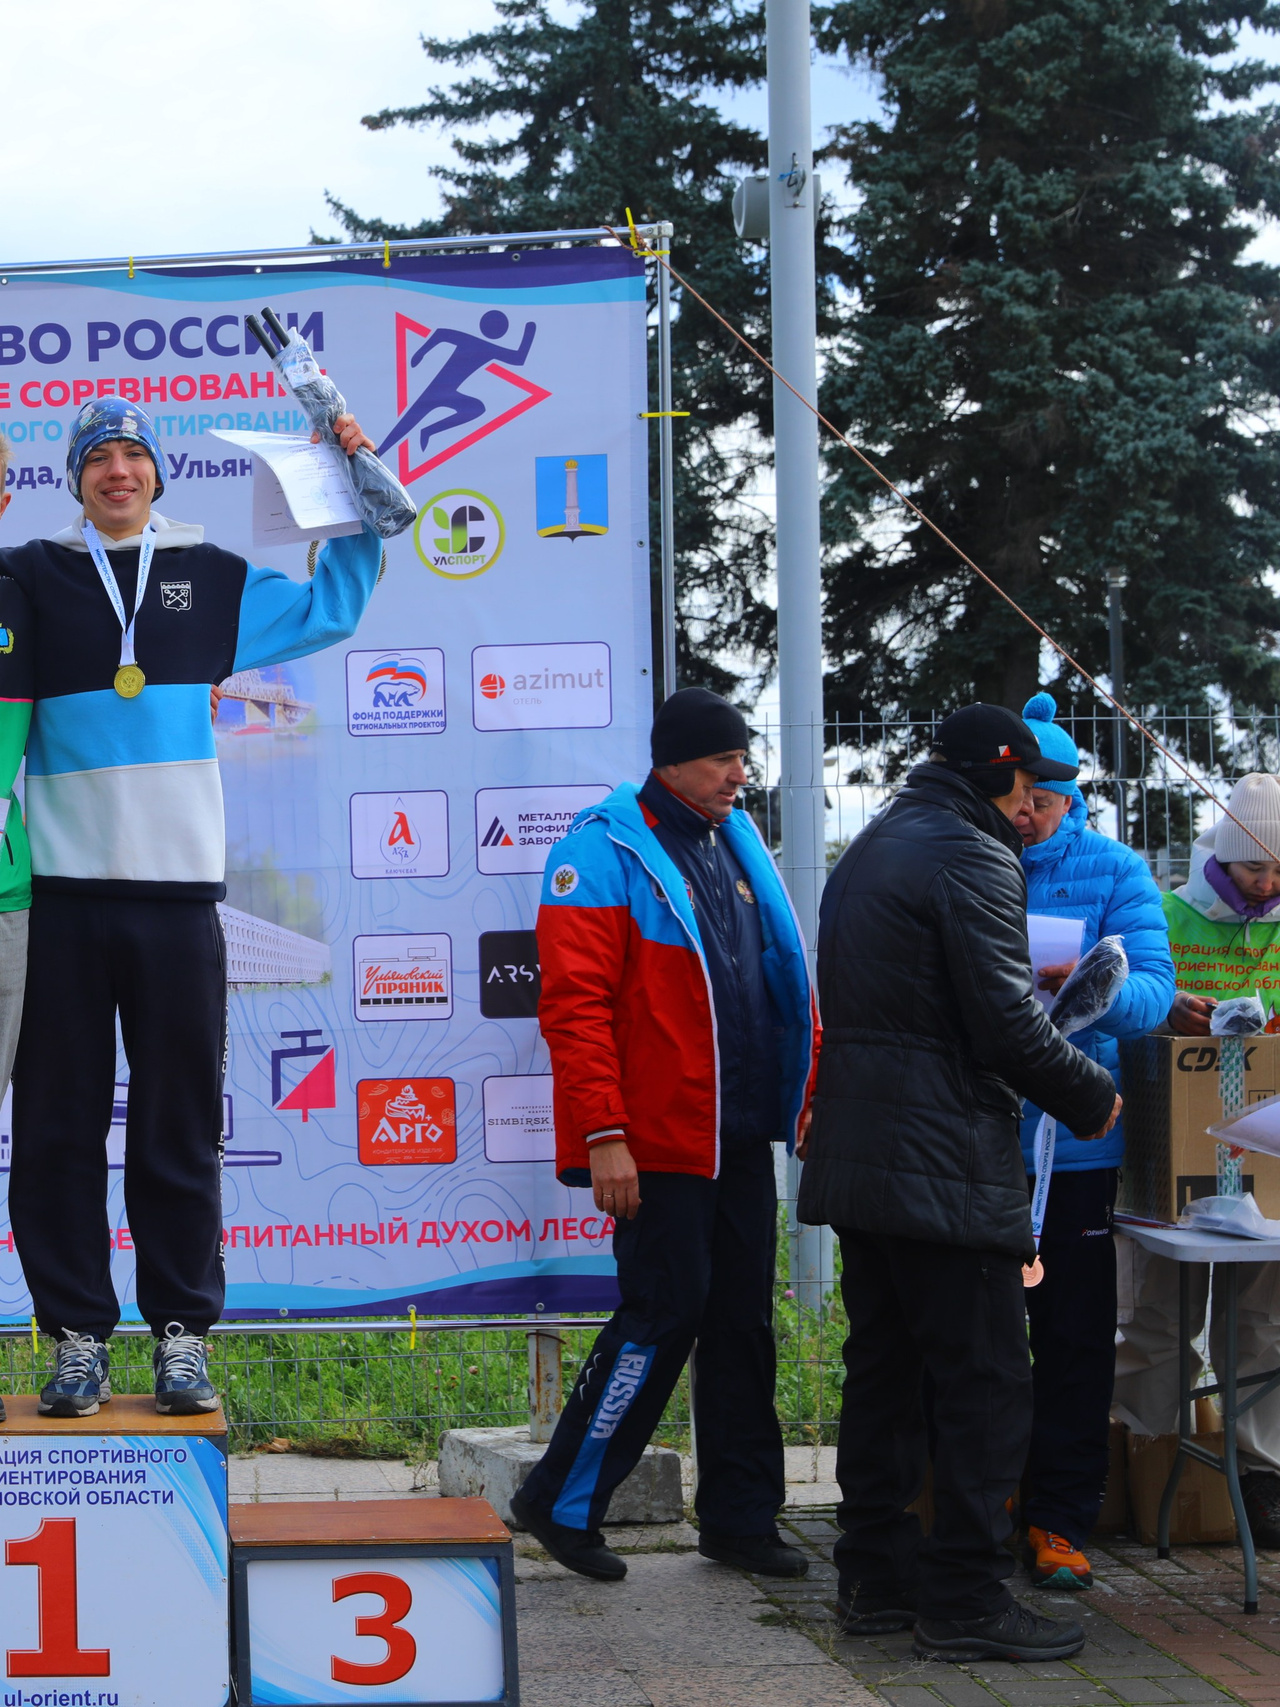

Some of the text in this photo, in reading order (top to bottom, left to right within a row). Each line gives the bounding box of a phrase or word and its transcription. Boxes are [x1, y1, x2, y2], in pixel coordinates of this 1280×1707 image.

[433, 555, 486, 566] УЛСПОРТ
[513, 668, 605, 691] azimut
[352, 708, 444, 722] ФОНД ПОДДЕРЖКИ
[351, 720, 446, 731] РЕГИОНАЛЬНЫХ ПРОЕКТОВ
[1169, 943, 1230, 957] ерация
[375, 980, 445, 994] ПРЯНИК
[1177, 1046, 1258, 1072] CDK
[416, 1219, 531, 1248] ДУХОМ
[590, 1353, 648, 1439] RUSSIA
[48, 1448, 187, 1464] СПОРТИВНОГО
[86, 1490, 174, 1505] ОБЛАСТИ
[5, 1517, 110, 1678] 1
[330, 1571, 417, 1686] 3
[4, 1689, 119, 1707] ul-orient.ru
